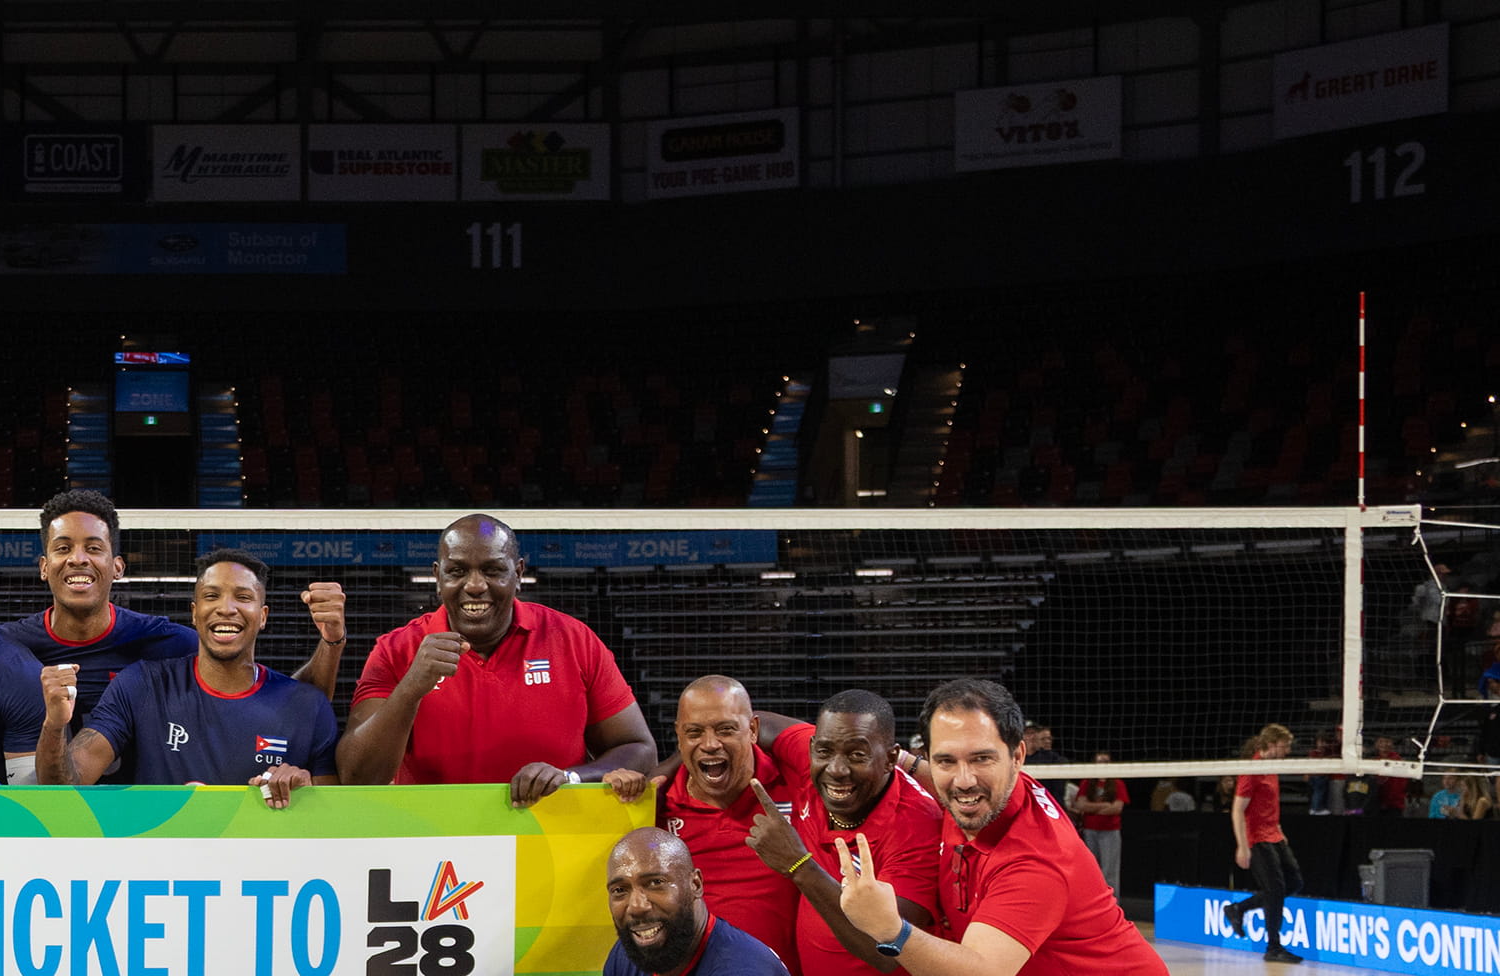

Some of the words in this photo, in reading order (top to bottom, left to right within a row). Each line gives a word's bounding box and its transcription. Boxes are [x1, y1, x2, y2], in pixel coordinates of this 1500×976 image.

[1315, 71, 1378, 99] GREAT
[1383, 61, 1437, 87] DANE
[50, 143, 116, 173] COAST
[201, 152, 288, 163] MARITIME
[337, 149, 374, 161] REAL
[377, 149, 443, 161] ATLANTIC
[197, 163, 291, 176] HYDRAULIC
[337, 161, 453, 175] SUPERSTORE
[653, 170, 688, 189] YOUR
[691, 164, 761, 186] PRE-GAME
[765, 161, 795, 180] HUB
[1343, 141, 1426, 204] 112
[227, 231, 295, 248] Subaru
[298, 231, 318, 248] of
[465, 221, 523, 269] 111
[227, 249, 309, 266] Moncton
[292, 541, 353, 559] ZONE
[627, 539, 689, 558] ZONE
[524, 670, 551, 686] CUB
[254, 753, 283, 765] CUB
[1204, 898, 1310, 949] NOCCA
[1315, 910, 1391, 960] MEN'S
[1396, 918, 1500, 975] CONTIN
